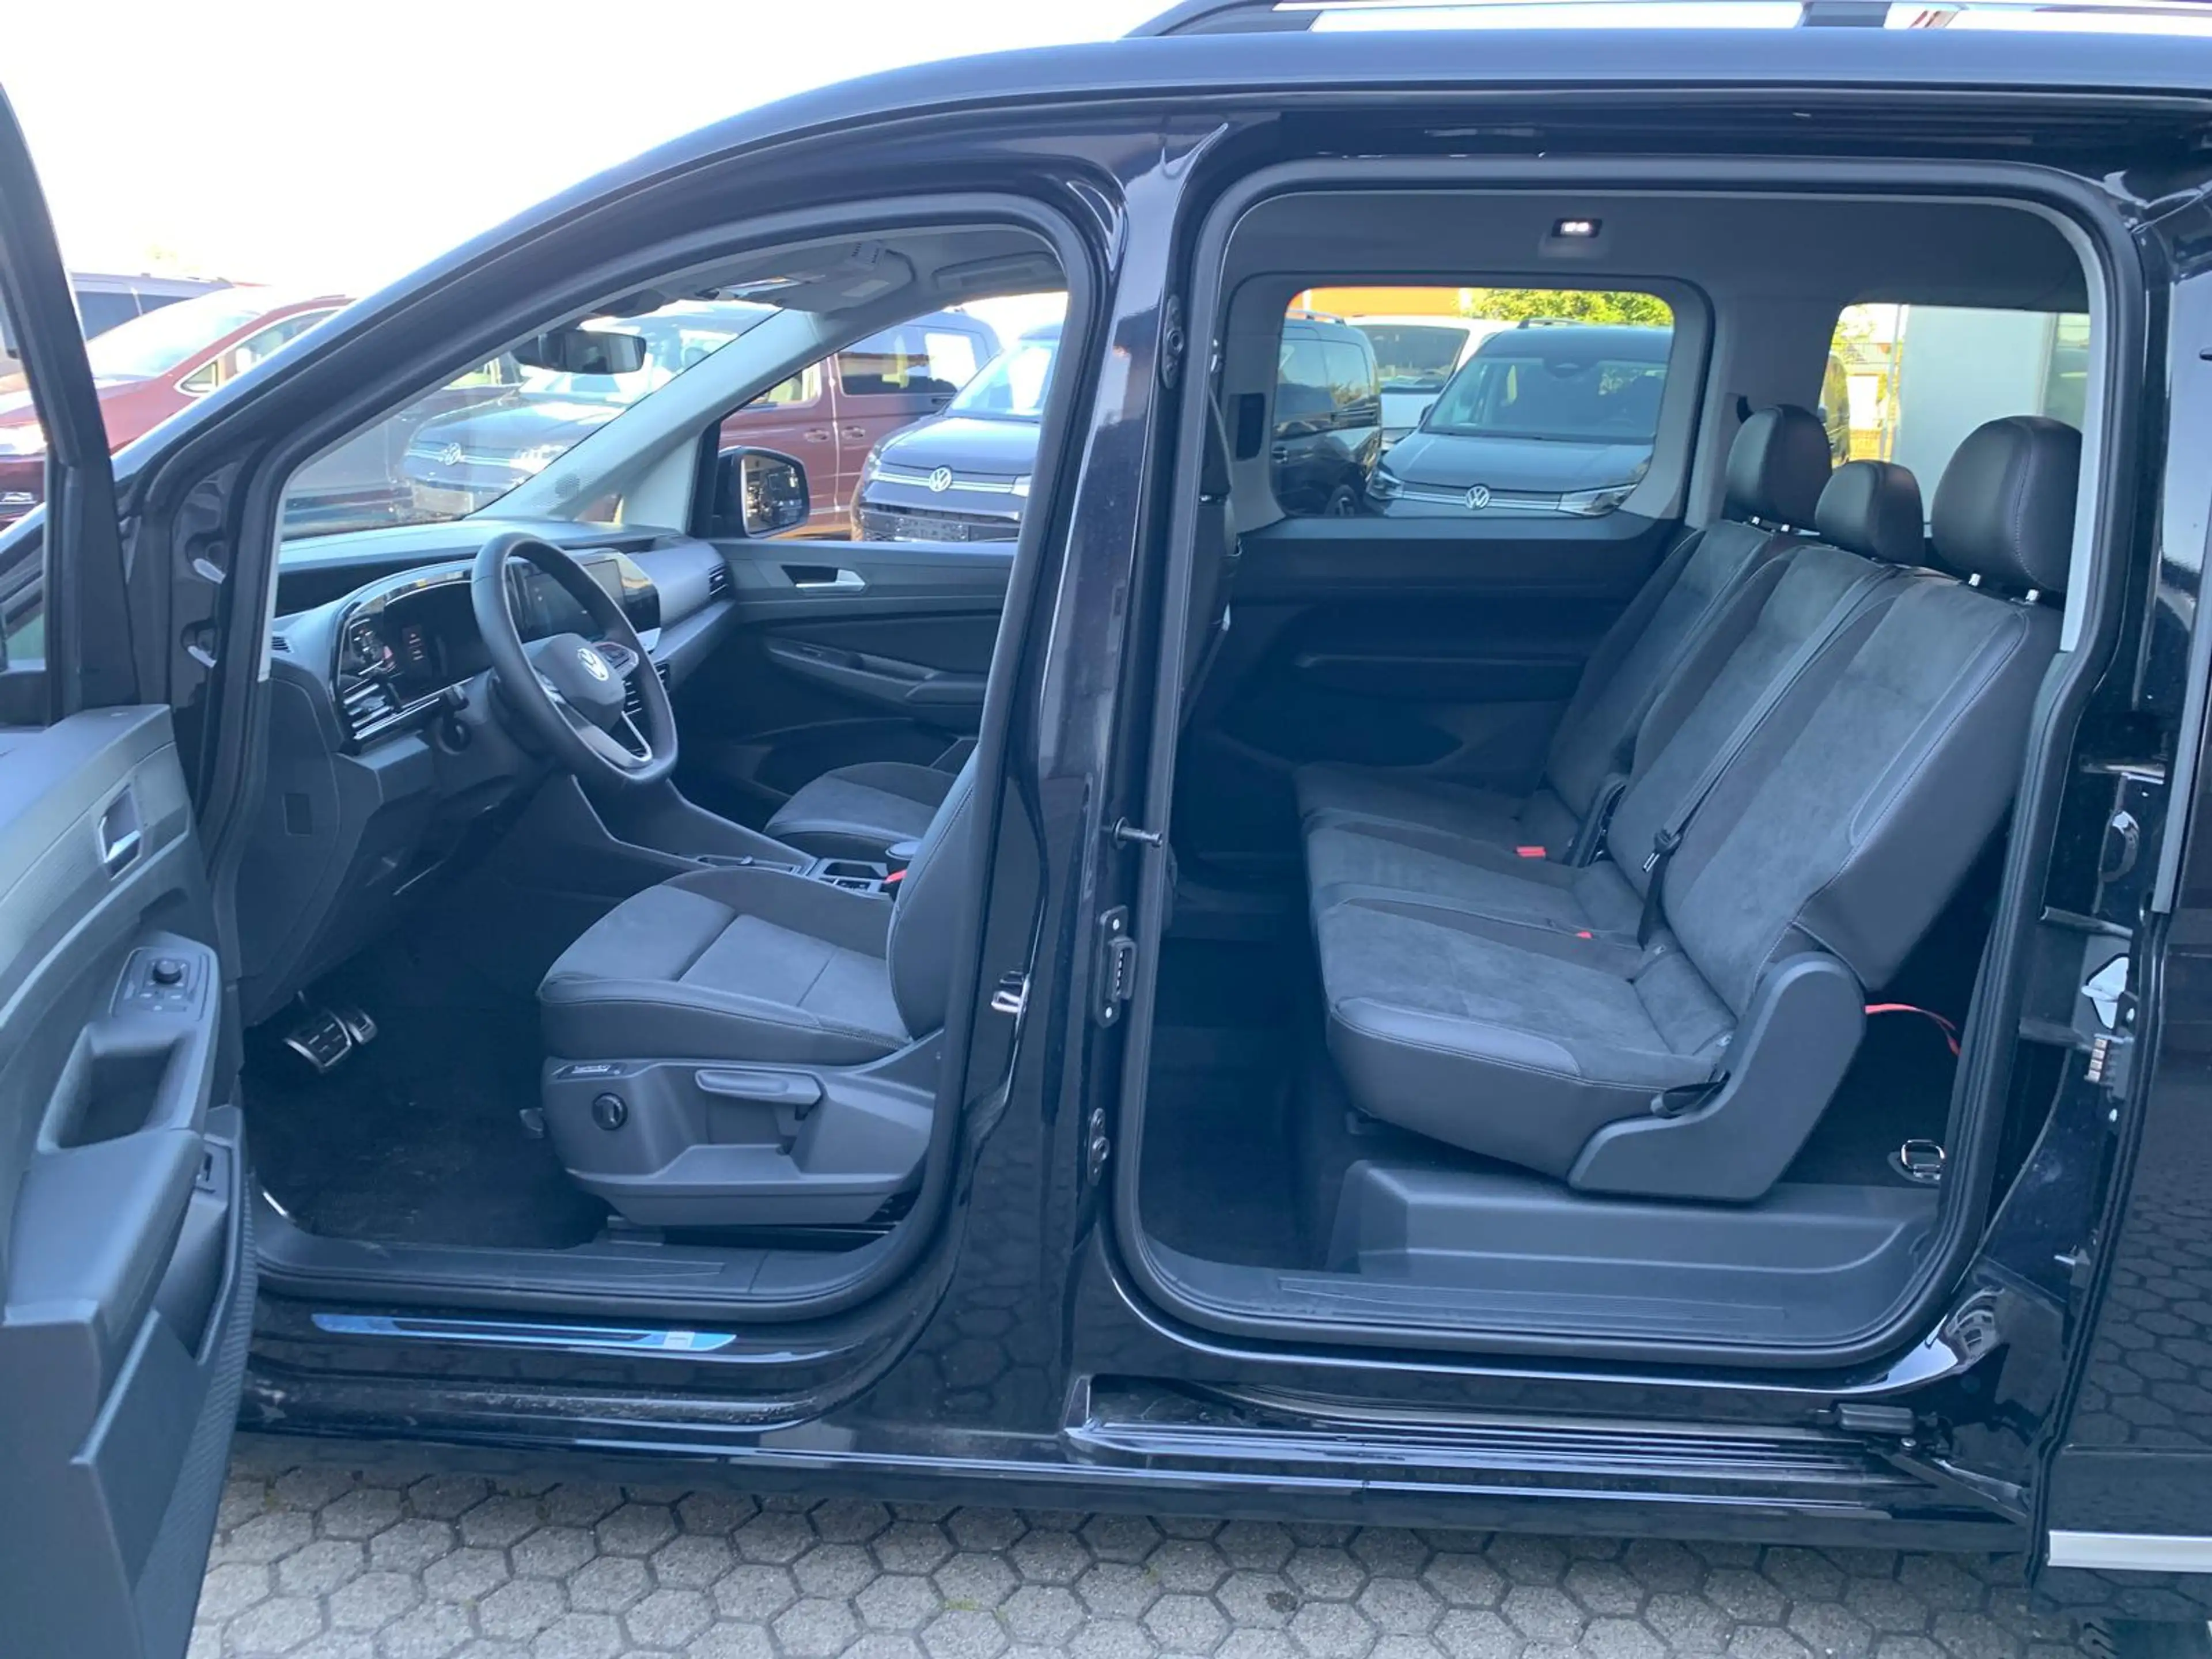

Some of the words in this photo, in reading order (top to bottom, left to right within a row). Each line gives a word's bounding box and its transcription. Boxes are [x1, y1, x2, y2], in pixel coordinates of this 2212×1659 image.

[929, 467, 952, 492] VW
[1465, 486, 1490, 510] VW
[577, 647, 609, 681] VW
